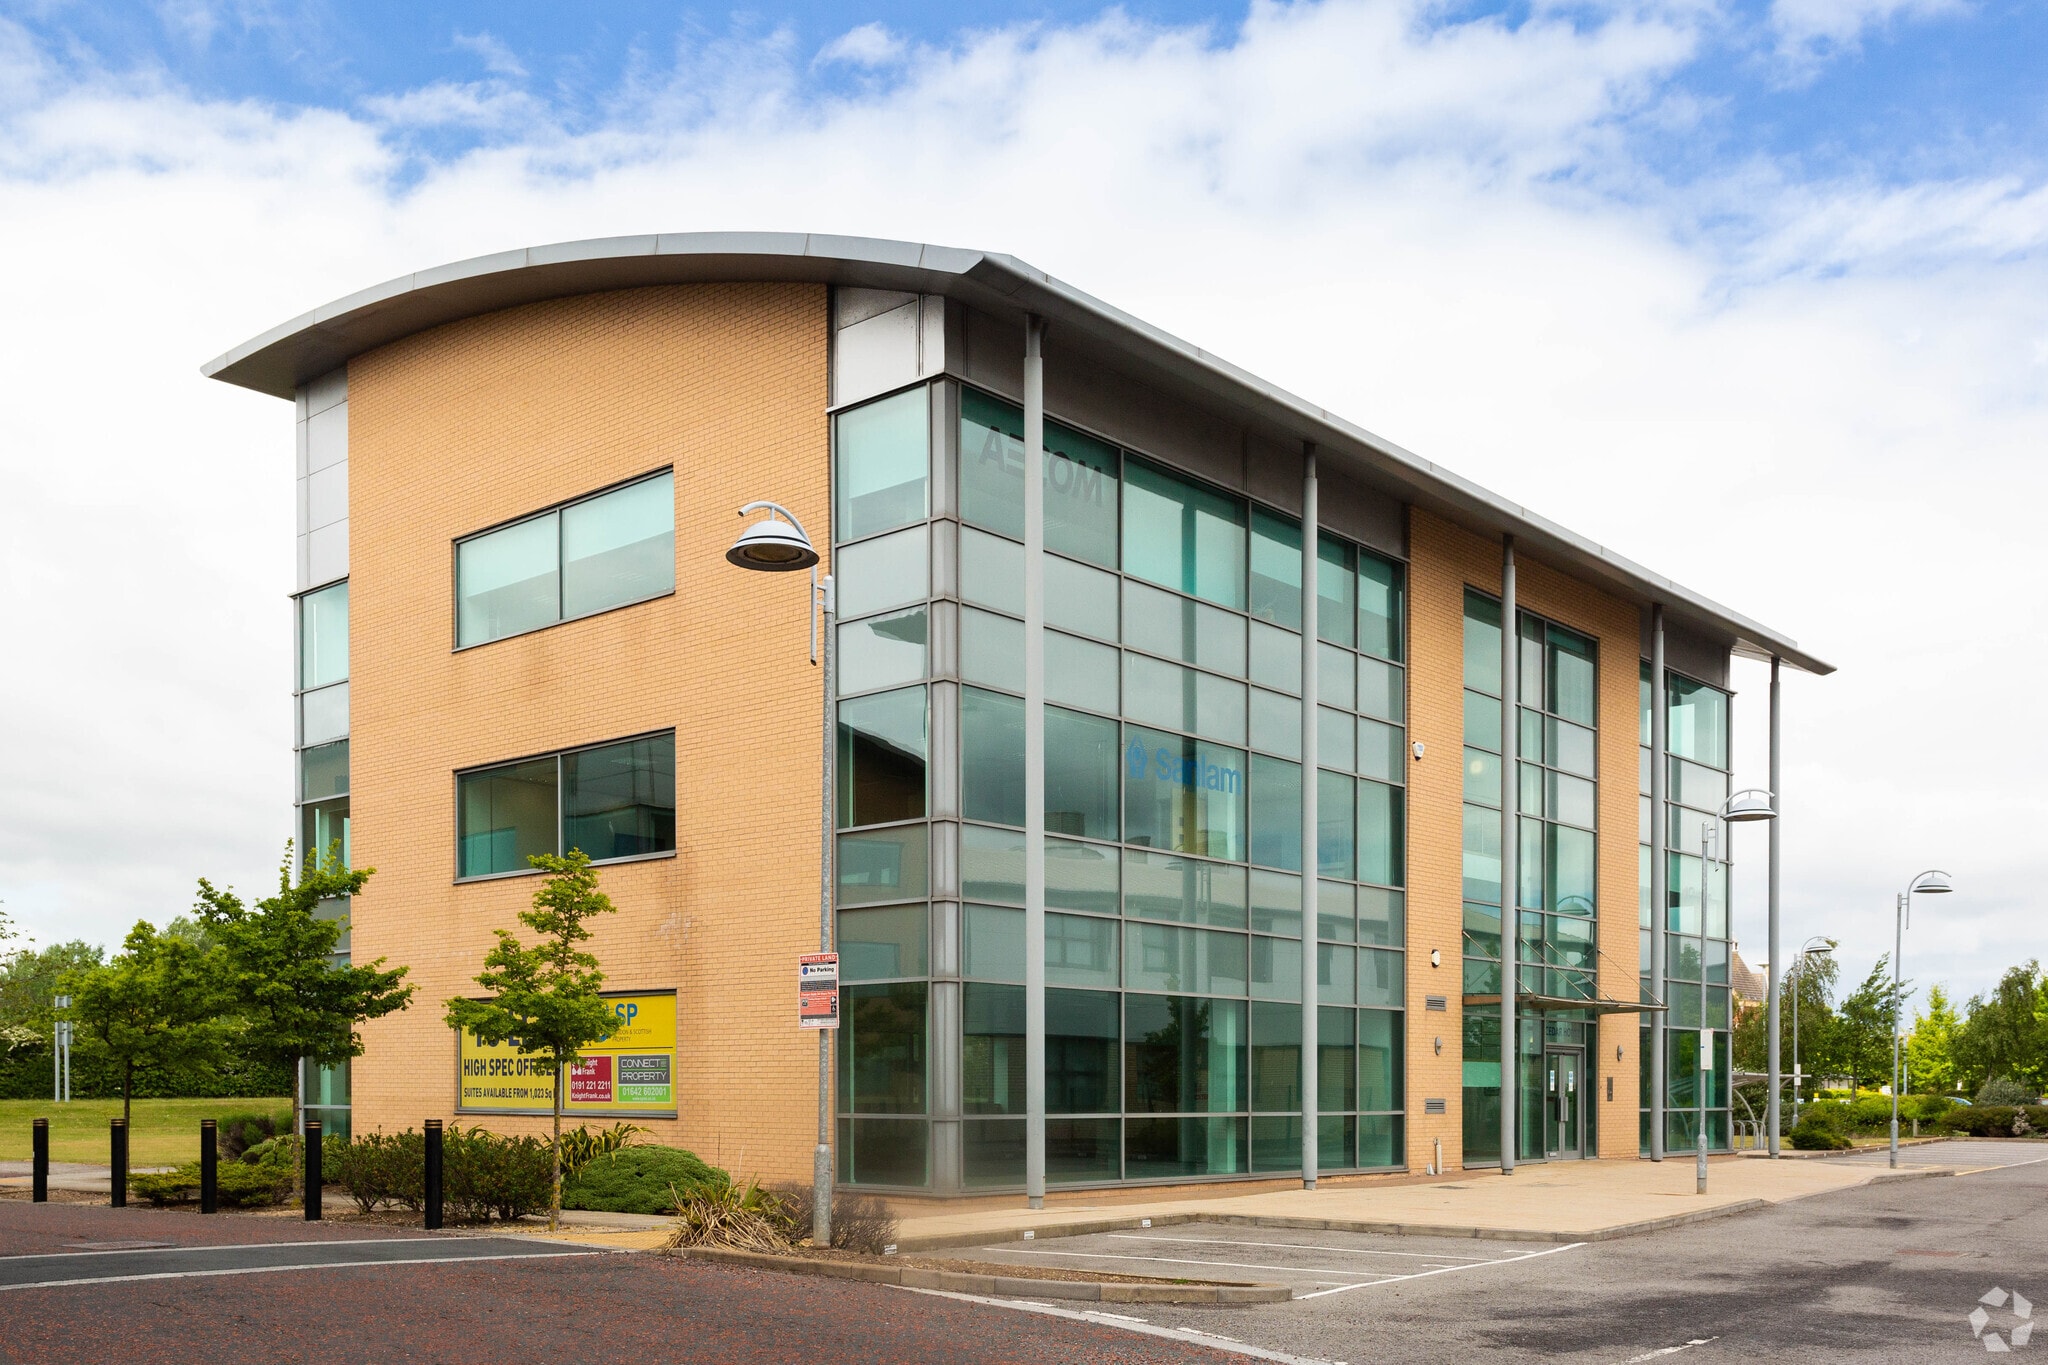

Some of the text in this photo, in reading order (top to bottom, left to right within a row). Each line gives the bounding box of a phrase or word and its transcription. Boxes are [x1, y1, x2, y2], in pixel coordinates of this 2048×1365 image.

[978, 426, 1103, 508] AEOM
[1156, 749, 1242, 796] Sanlam
[464, 1059, 486, 1076] HIGH
[489, 1059, 514, 1076] SPEC
[621, 1059, 660, 1068] CONNECT
[621, 1071, 667, 1080] PROPERTY
[572, 1081, 611, 1090] 0191 221 2211
[464, 1088, 482, 1098] SUITES
[484, 1088, 512, 1098] AVAILABLE
[513, 1088, 528, 1098] FROM
[529, 1088, 544, 1100] 1,023
[545, 1088, 552, 1101] Sq
